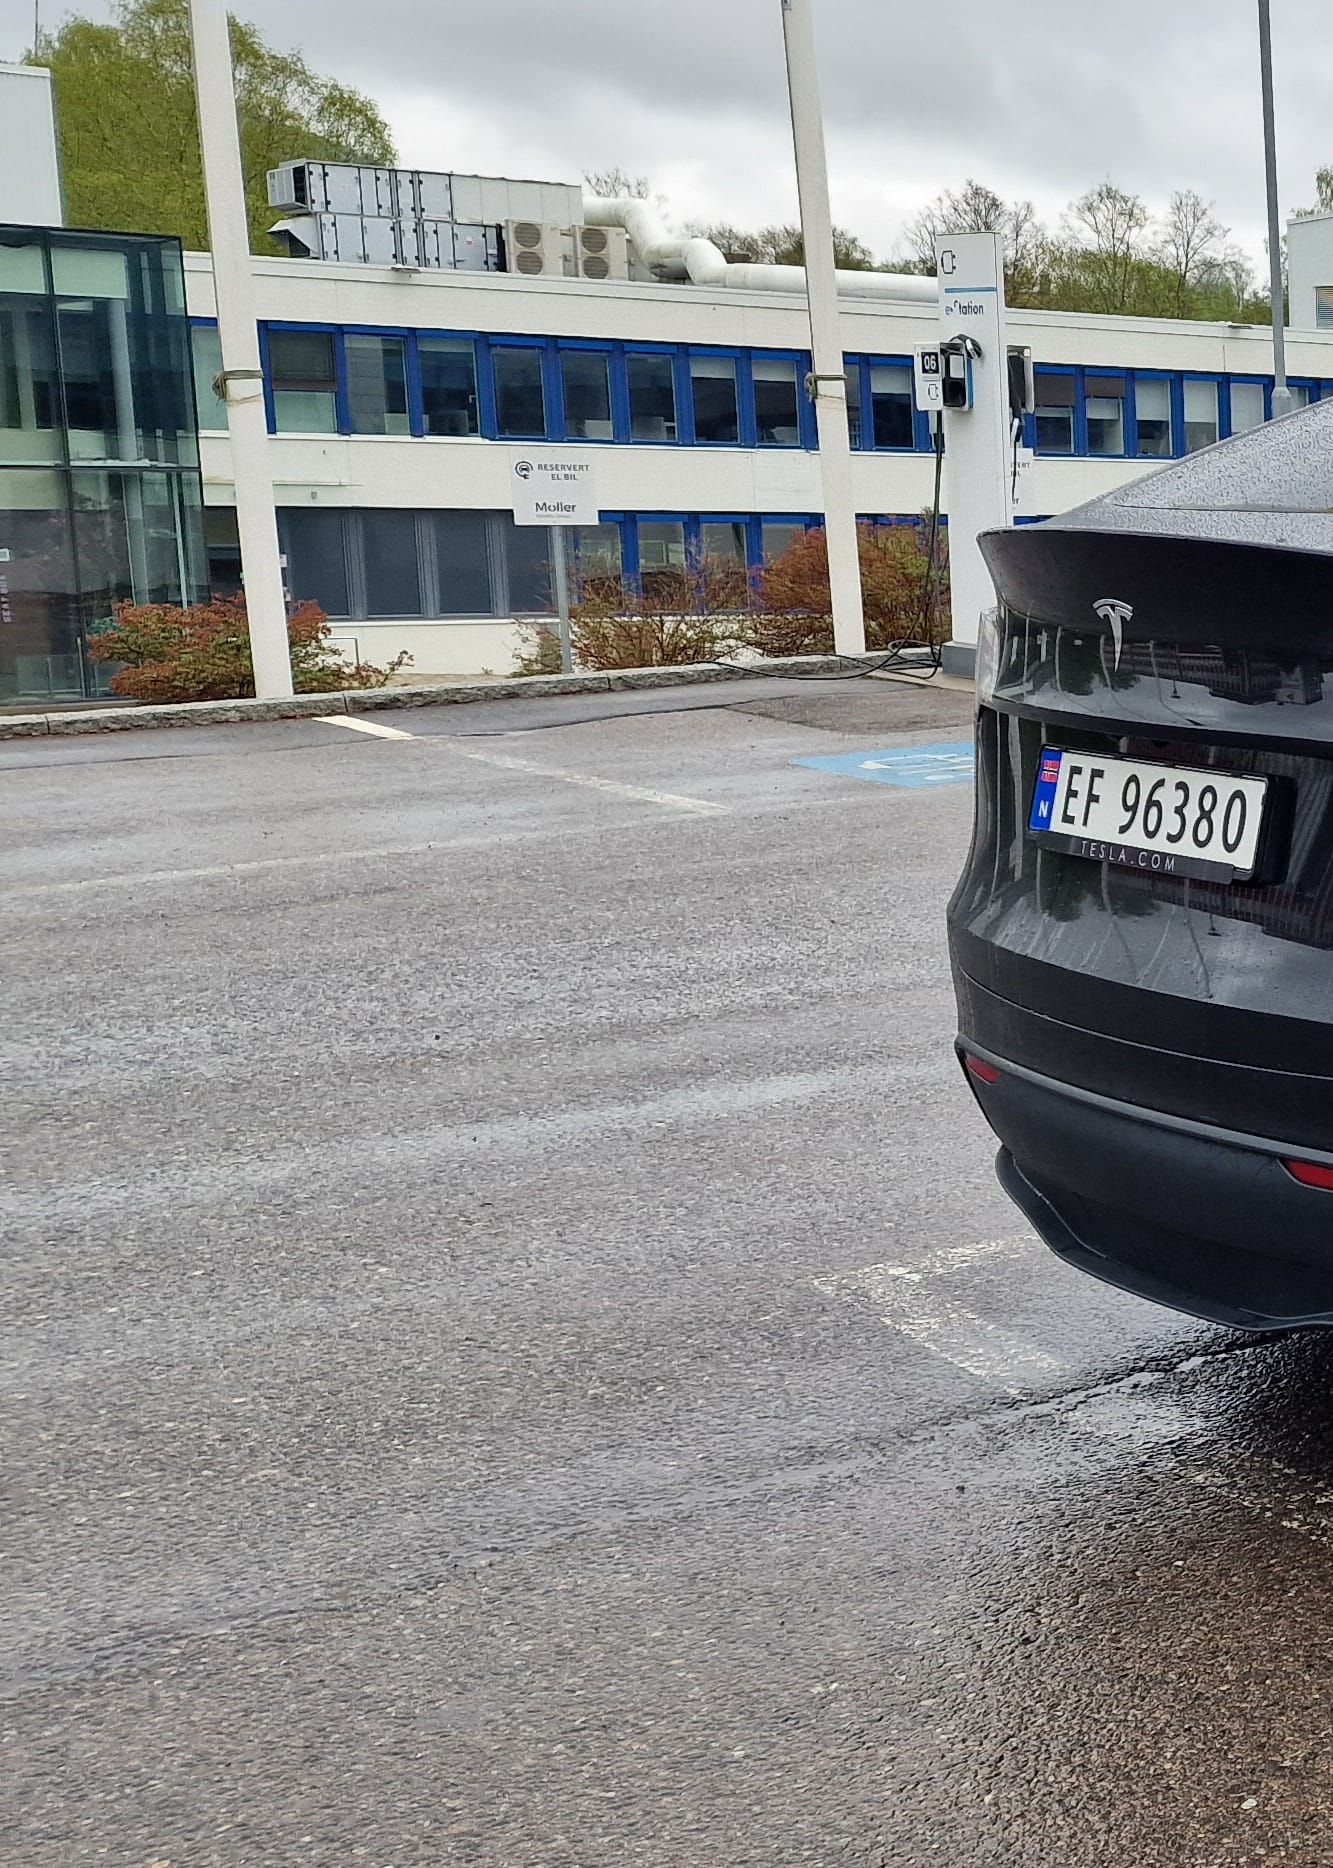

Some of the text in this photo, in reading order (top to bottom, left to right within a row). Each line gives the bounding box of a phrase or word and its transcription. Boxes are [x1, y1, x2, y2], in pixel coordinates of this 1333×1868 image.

[923, 355, 936, 371] 06
[537, 463, 590, 472] RESERVERT
[551, 473, 579, 481] EL BIL
[1038, 801, 1049, 818] N
[1061, 765, 1247, 853] EF 96380
[1080, 841, 1176, 872] TESLA.COM
